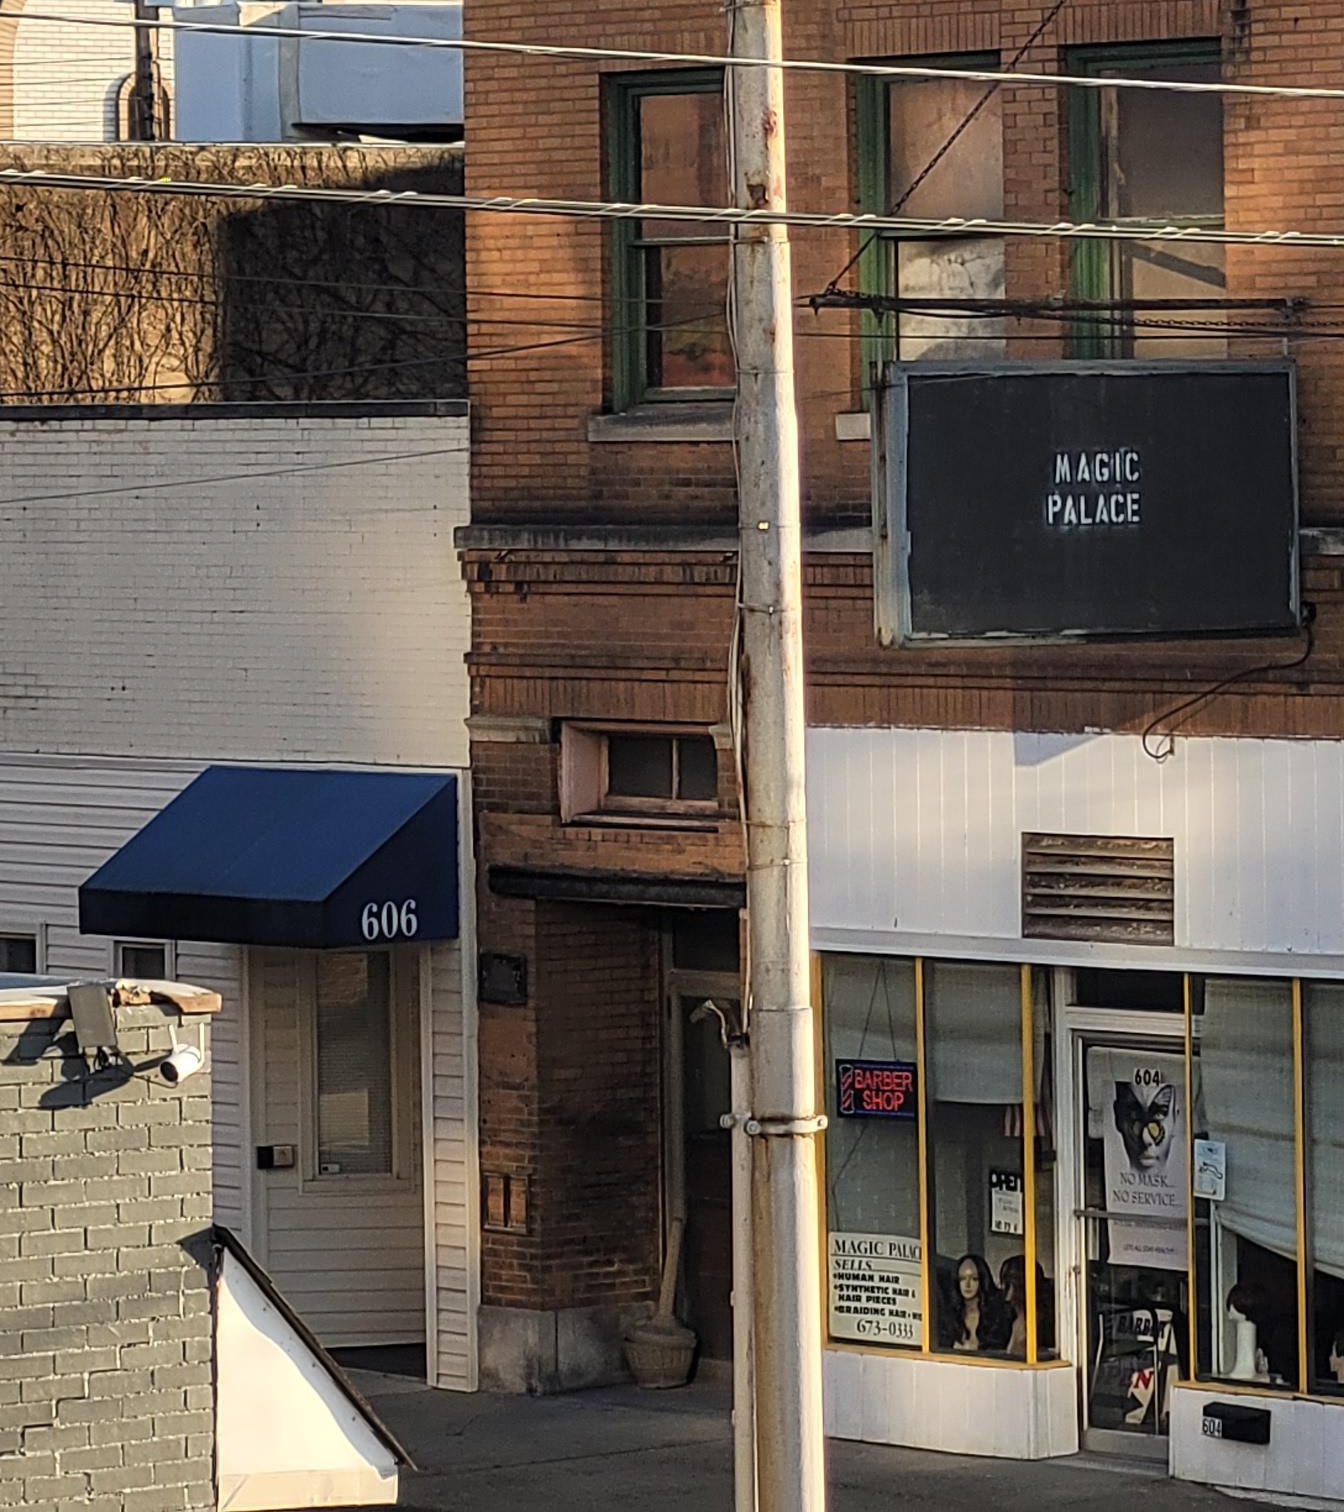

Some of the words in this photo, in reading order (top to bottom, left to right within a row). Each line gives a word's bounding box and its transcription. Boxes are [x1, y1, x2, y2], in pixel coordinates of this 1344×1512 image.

[1055, 452, 1139, 483] MAGIC
[1048, 493, 1140, 524] PALACE
[361, 899, 418, 940] 606
[854, 1069, 913, 1092] BARBER
[1135, 1068, 1159, 1087] 604
[863, 1089, 904, 1111] SHOP
[1120, 1172, 1136, 1185] NO
[1113, 1190, 1129, 1204] NO
[834, 1239, 884, 1256] MAGIC
[889, 1242, 922, 1260] PALAC
[834, 1259, 873, 1271] SELLS
[879, 1274, 900, 1285] HAIR
[838, 1283, 890, 1295] SYNTHETIC
[838, 1294, 862, 1303] HAIR
[866, 1295, 897, 1306] PIECES
[1202, 1418, 1222, 1434] 604
